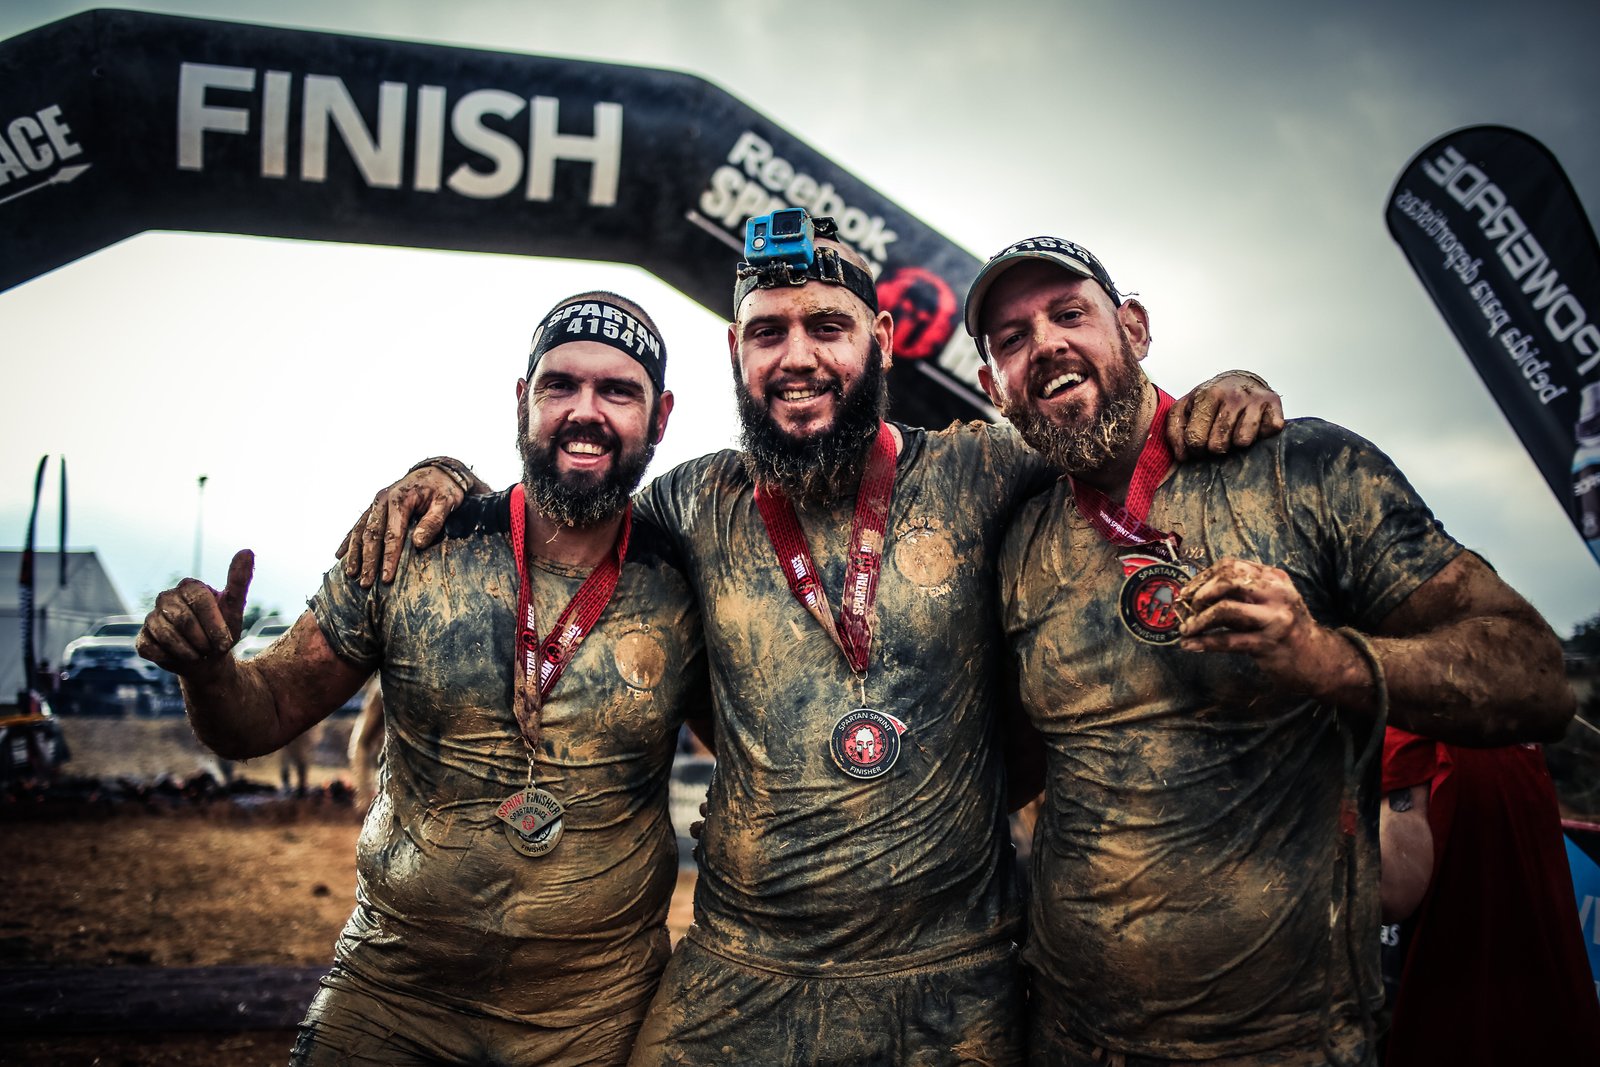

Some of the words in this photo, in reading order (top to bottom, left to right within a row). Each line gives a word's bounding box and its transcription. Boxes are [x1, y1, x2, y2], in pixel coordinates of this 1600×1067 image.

[177, 61, 623, 206] FINISH
[727, 130, 898, 262] Reebok
[547, 303, 661, 360] SPARTAN
[566, 317, 644, 356] 41547
[791, 554, 807, 580] RACE
[1139, 567, 1177, 580] SPARTAN
[852, 573, 869, 616] SPARTAN
[526, 604, 535, 630] RACE
[838, 712, 868, 731] SPARTAN
[869, 713, 893, 732] SPRINT
[849, 766, 882, 775] FINISHER
[497, 793, 525, 817] SPRINT
[526, 792, 560, 815] FINISHER
[510, 806, 533, 822] SPARTAN
[521, 843, 549, 853] FINISHER
